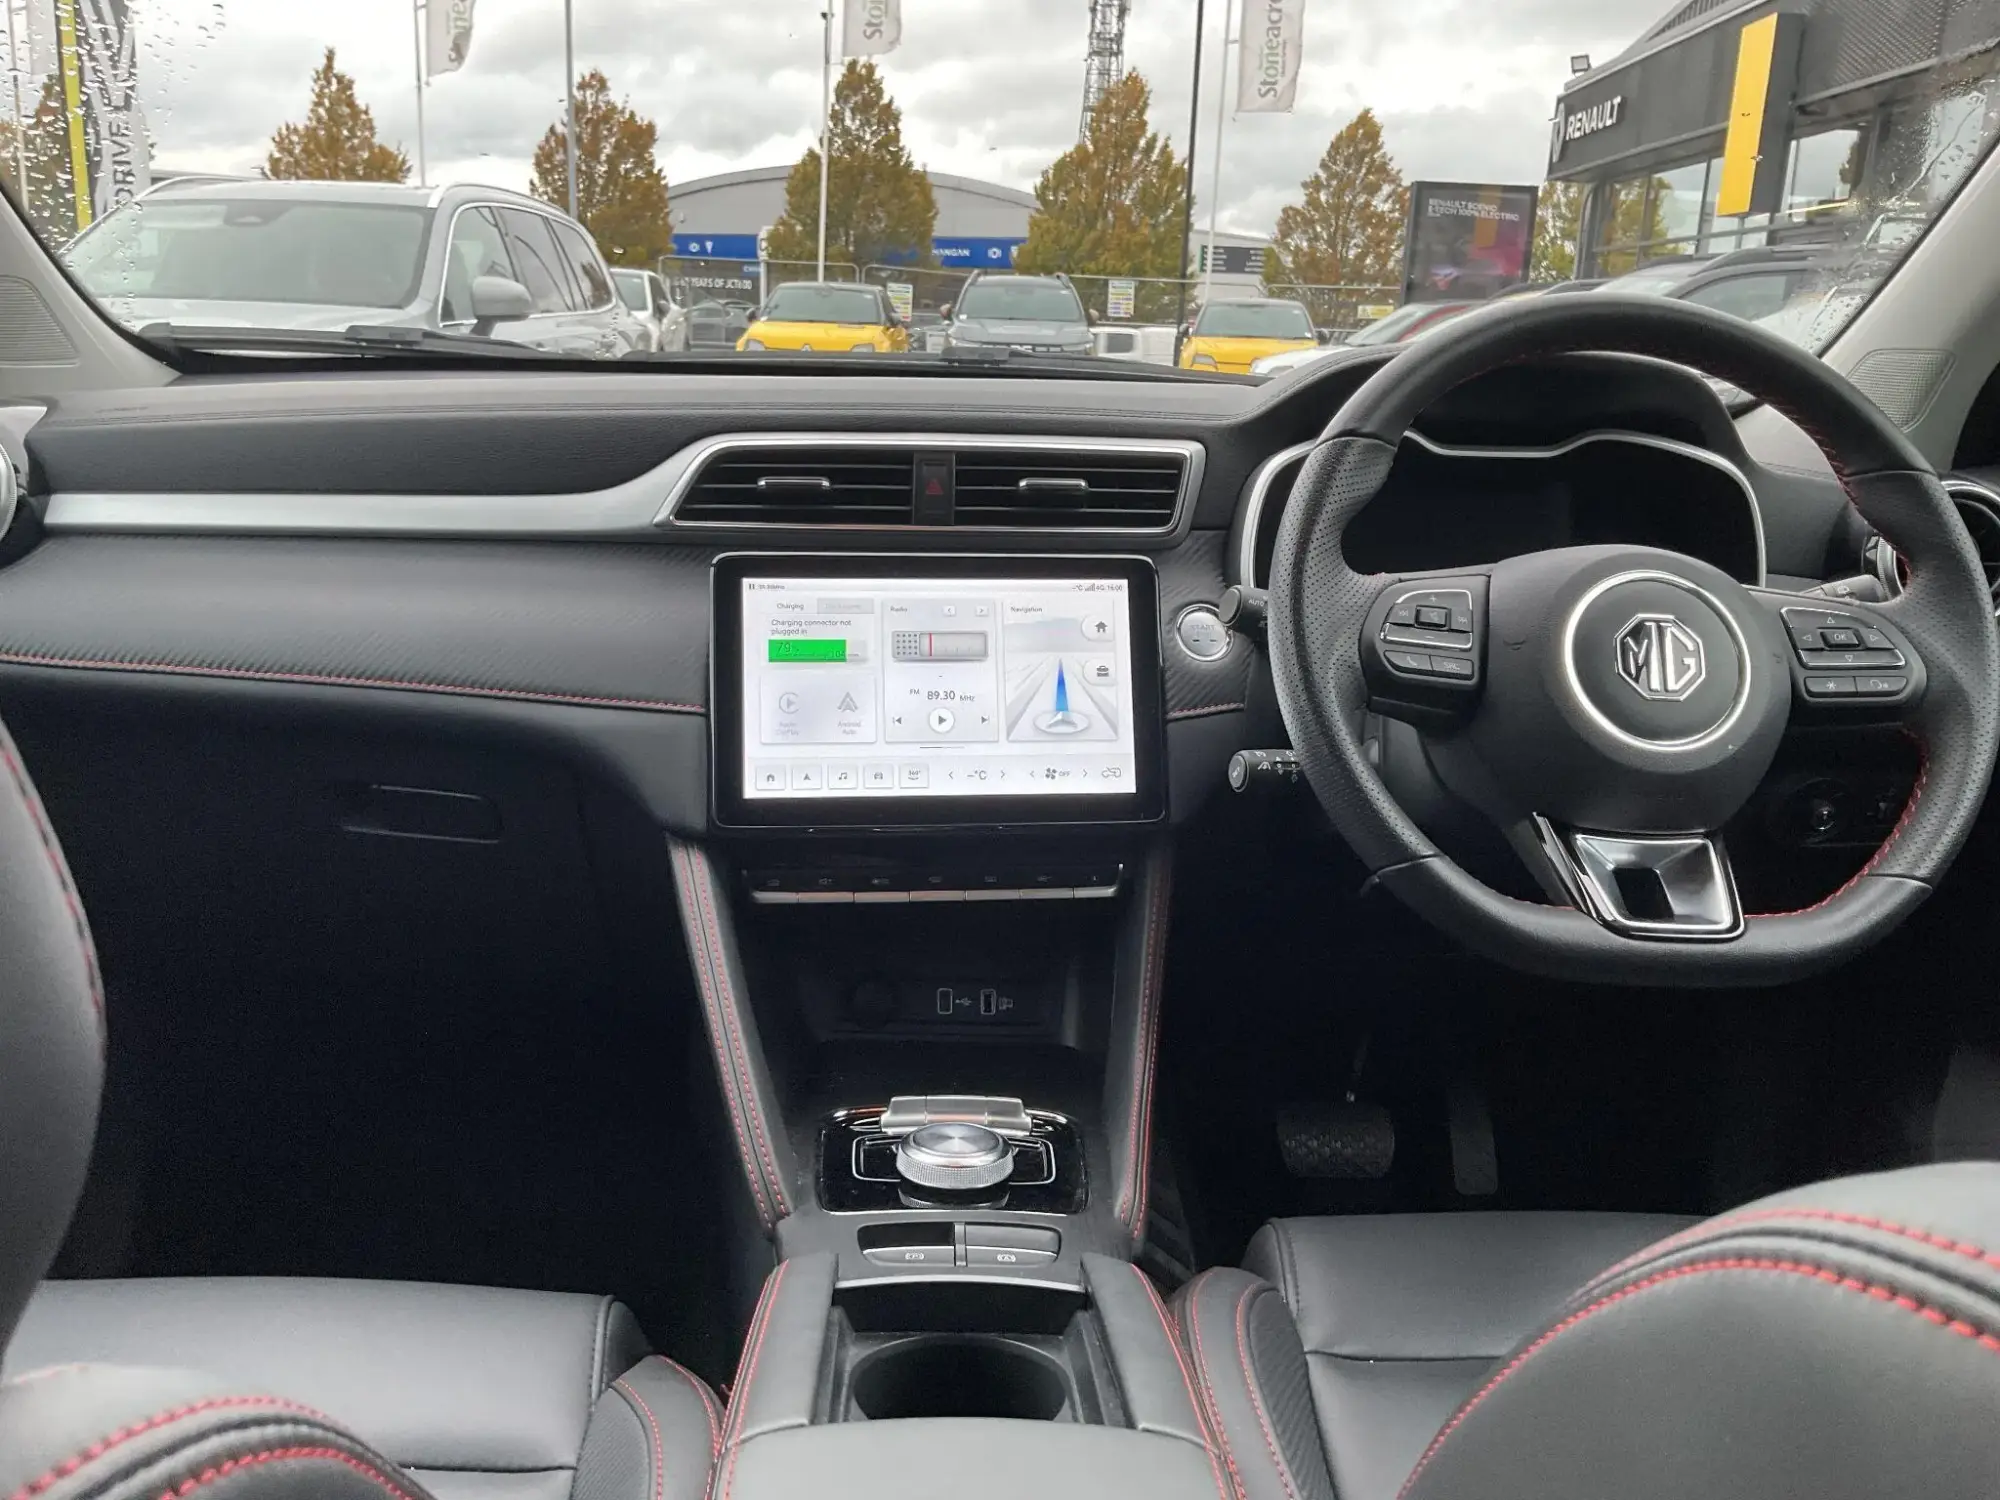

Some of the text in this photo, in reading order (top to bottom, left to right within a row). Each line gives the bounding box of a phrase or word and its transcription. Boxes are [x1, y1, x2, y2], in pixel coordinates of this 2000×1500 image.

[1566, 95, 1622, 141] RENAULT
[1428, 198, 1467, 209] RENAULT
[1480, 211, 1520, 221] ELECTRIC
[776, 602, 805, 611] Charging
[1010, 605, 1043, 613] Navigation
[771, 618, 852, 627] Charging connector not
[771, 628, 799, 637] plugged
[1833, 633, 1847, 641] OK
[1623, 620, 1697, 692] MG
[927, 690, 956, 701] 89.30
[1058, 770, 1071, 778] OFF
